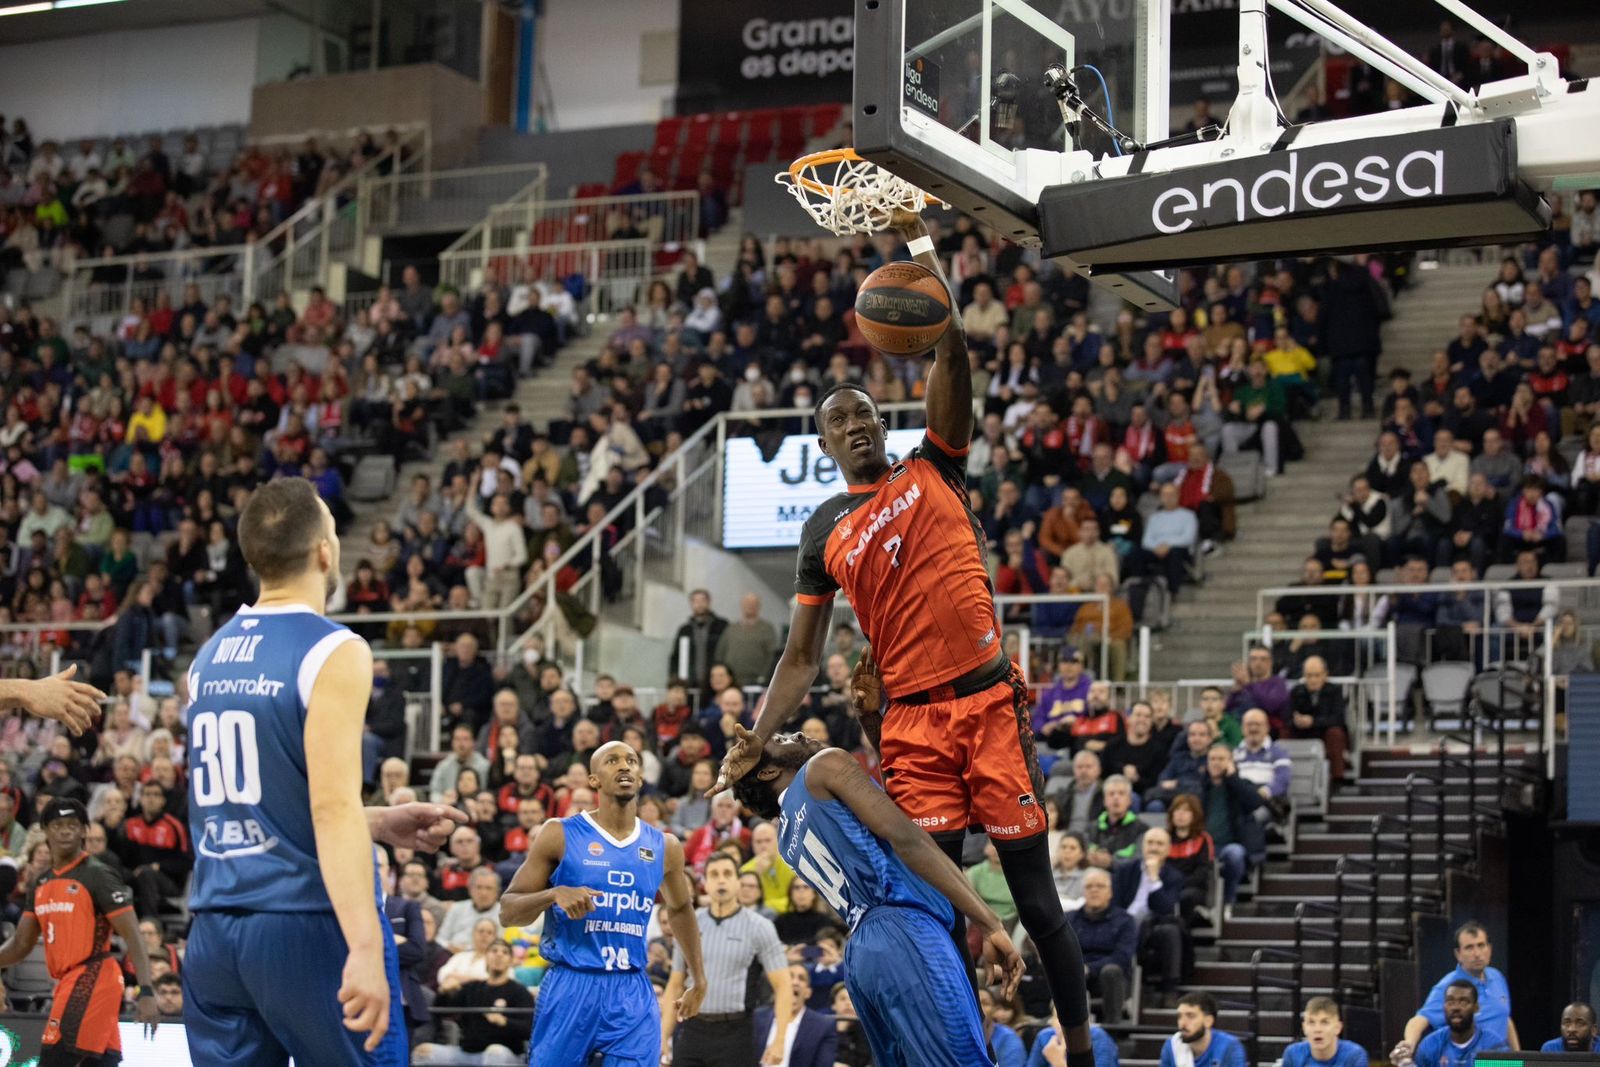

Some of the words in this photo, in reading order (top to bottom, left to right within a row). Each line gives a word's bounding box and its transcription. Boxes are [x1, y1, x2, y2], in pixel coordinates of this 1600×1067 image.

[741, 54, 775, 79] es
[905, 62, 921, 84] liga
[905, 83, 938, 112] endesa
[1152, 150, 1444, 234] endesa
[882, 534, 903, 568] 7
[211, 634, 264, 664] NOVAK
[192, 710, 262, 807] 30
[592, 889, 654, 916] arplus
[601, 946, 632, 971] 24
